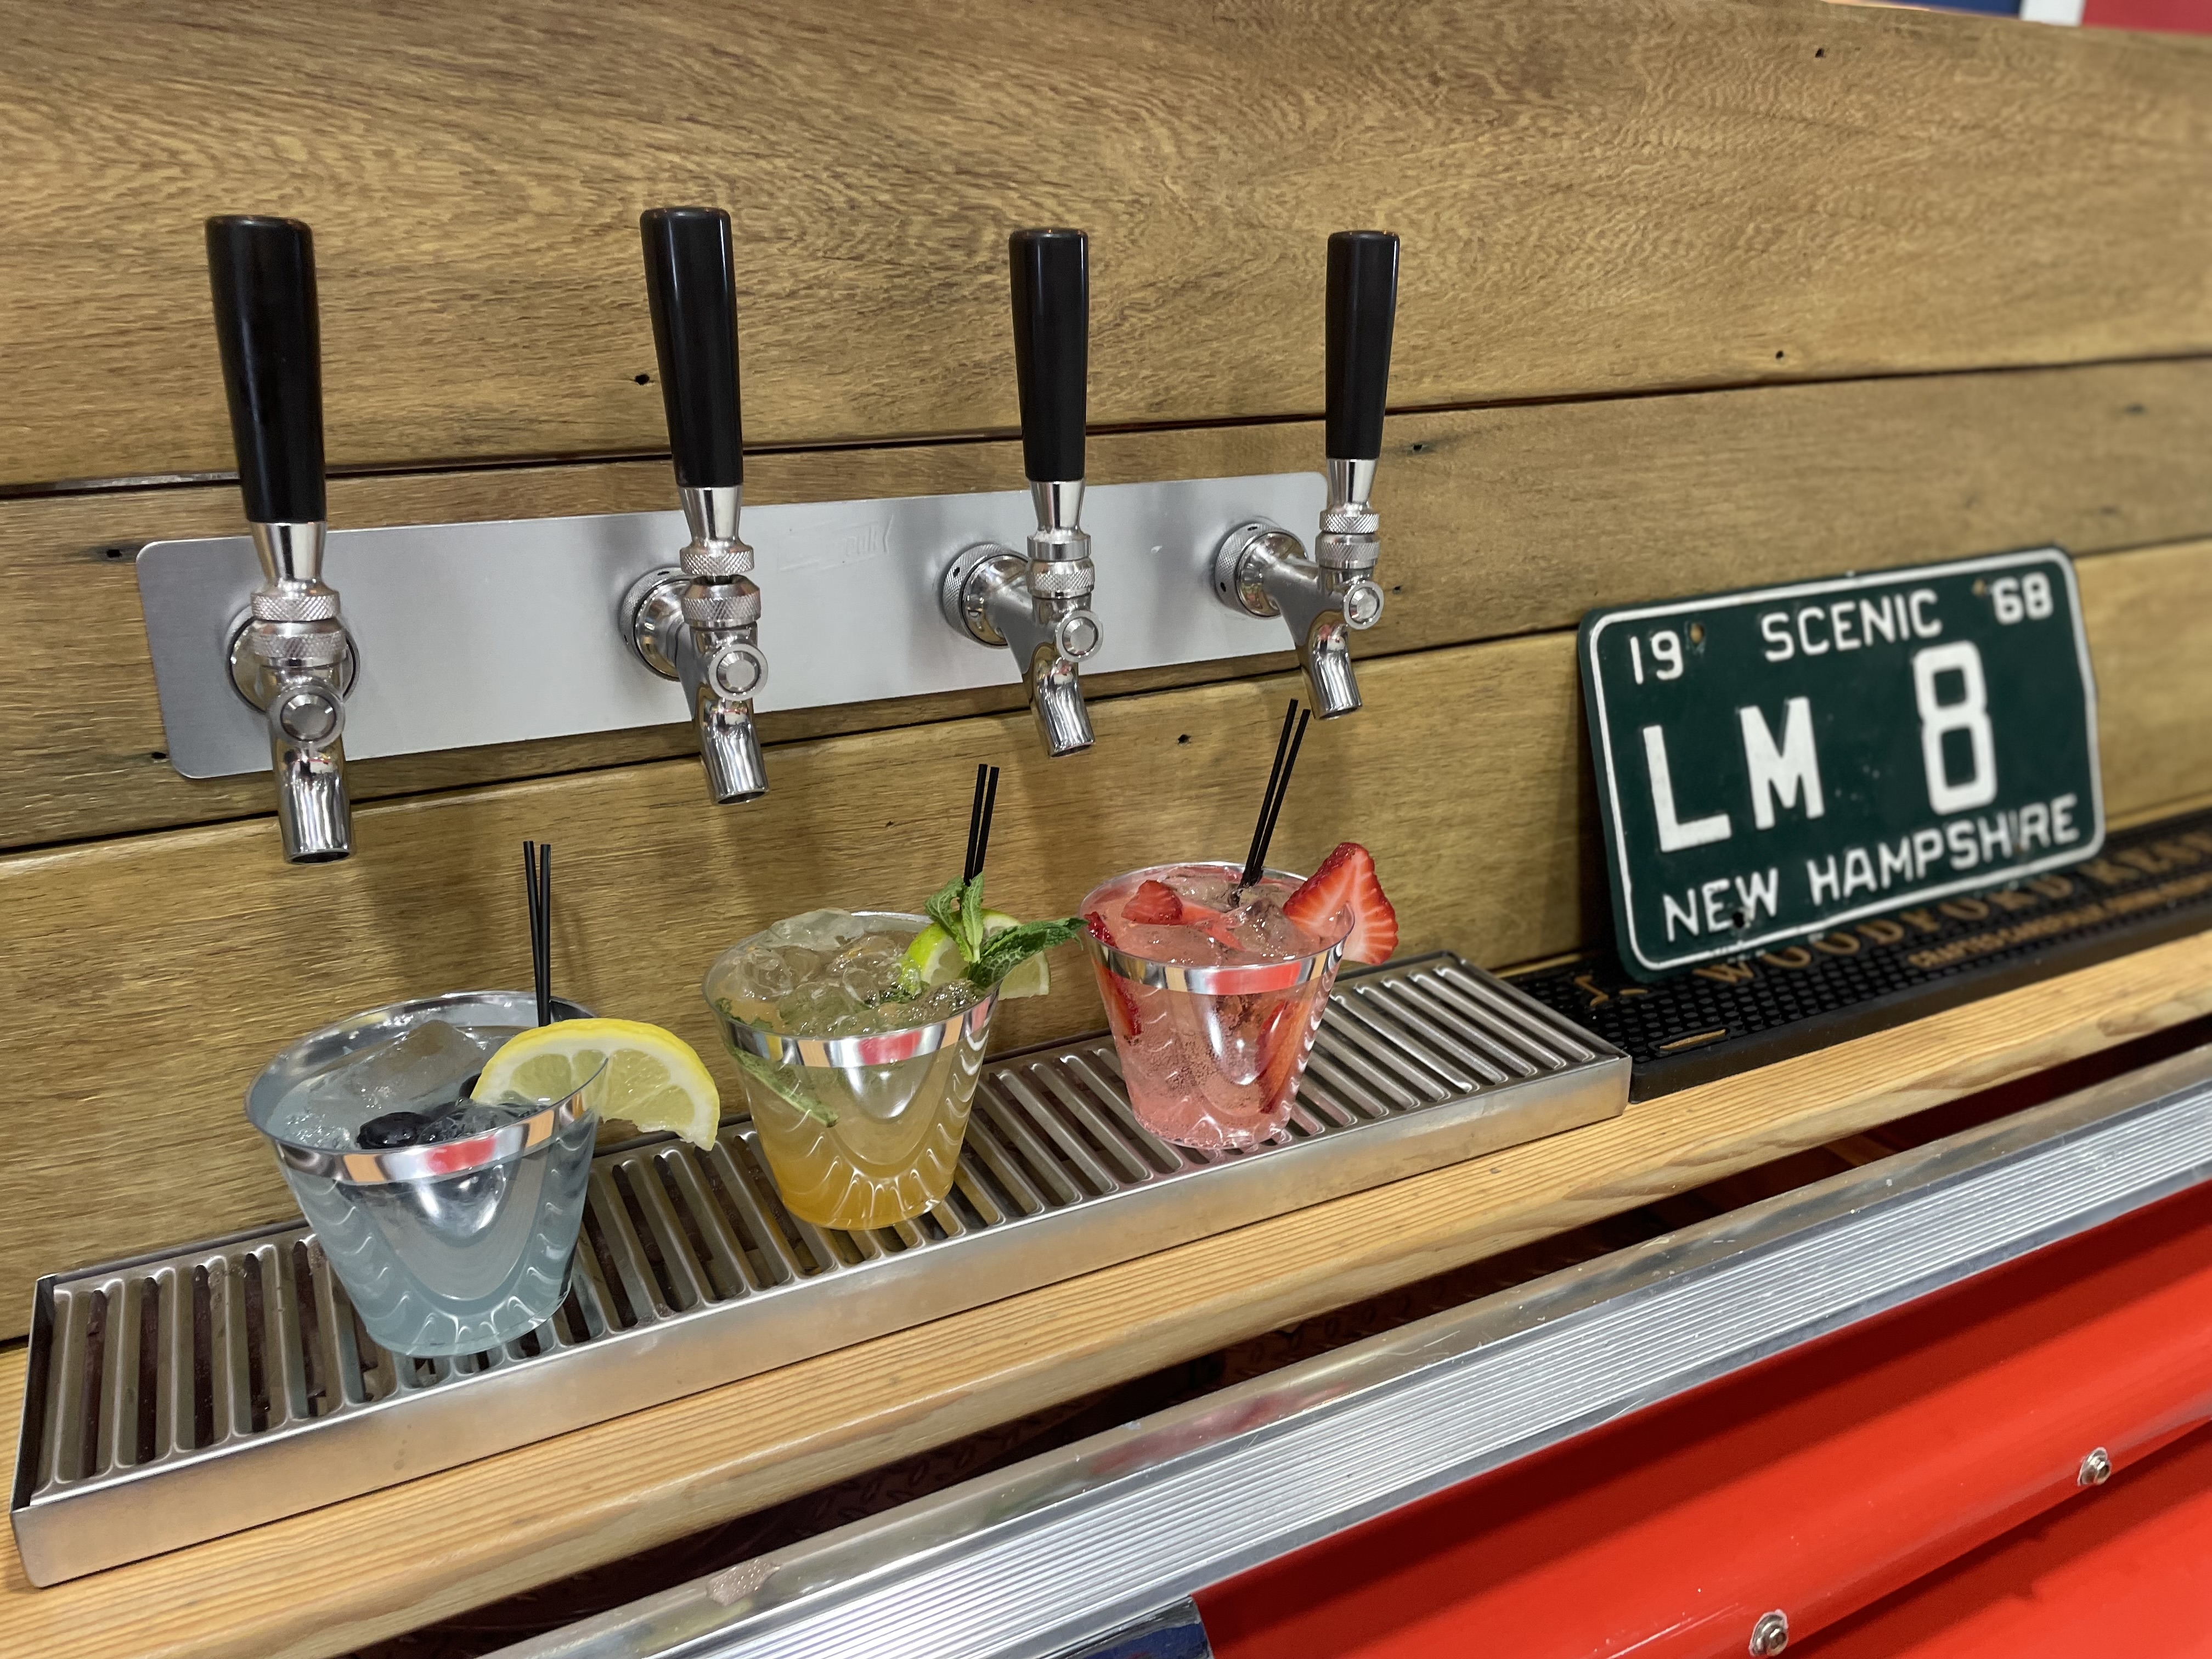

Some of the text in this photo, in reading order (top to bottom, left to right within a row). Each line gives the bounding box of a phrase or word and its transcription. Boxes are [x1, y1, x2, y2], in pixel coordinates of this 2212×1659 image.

[1630, 572, 2053, 685] 19 SCENIC 68
[1912, 640, 1997, 815] 8
[1662, 868, 1779, 943] NEW
[1806, 793, 2081, 906] HAMPSHIRE
